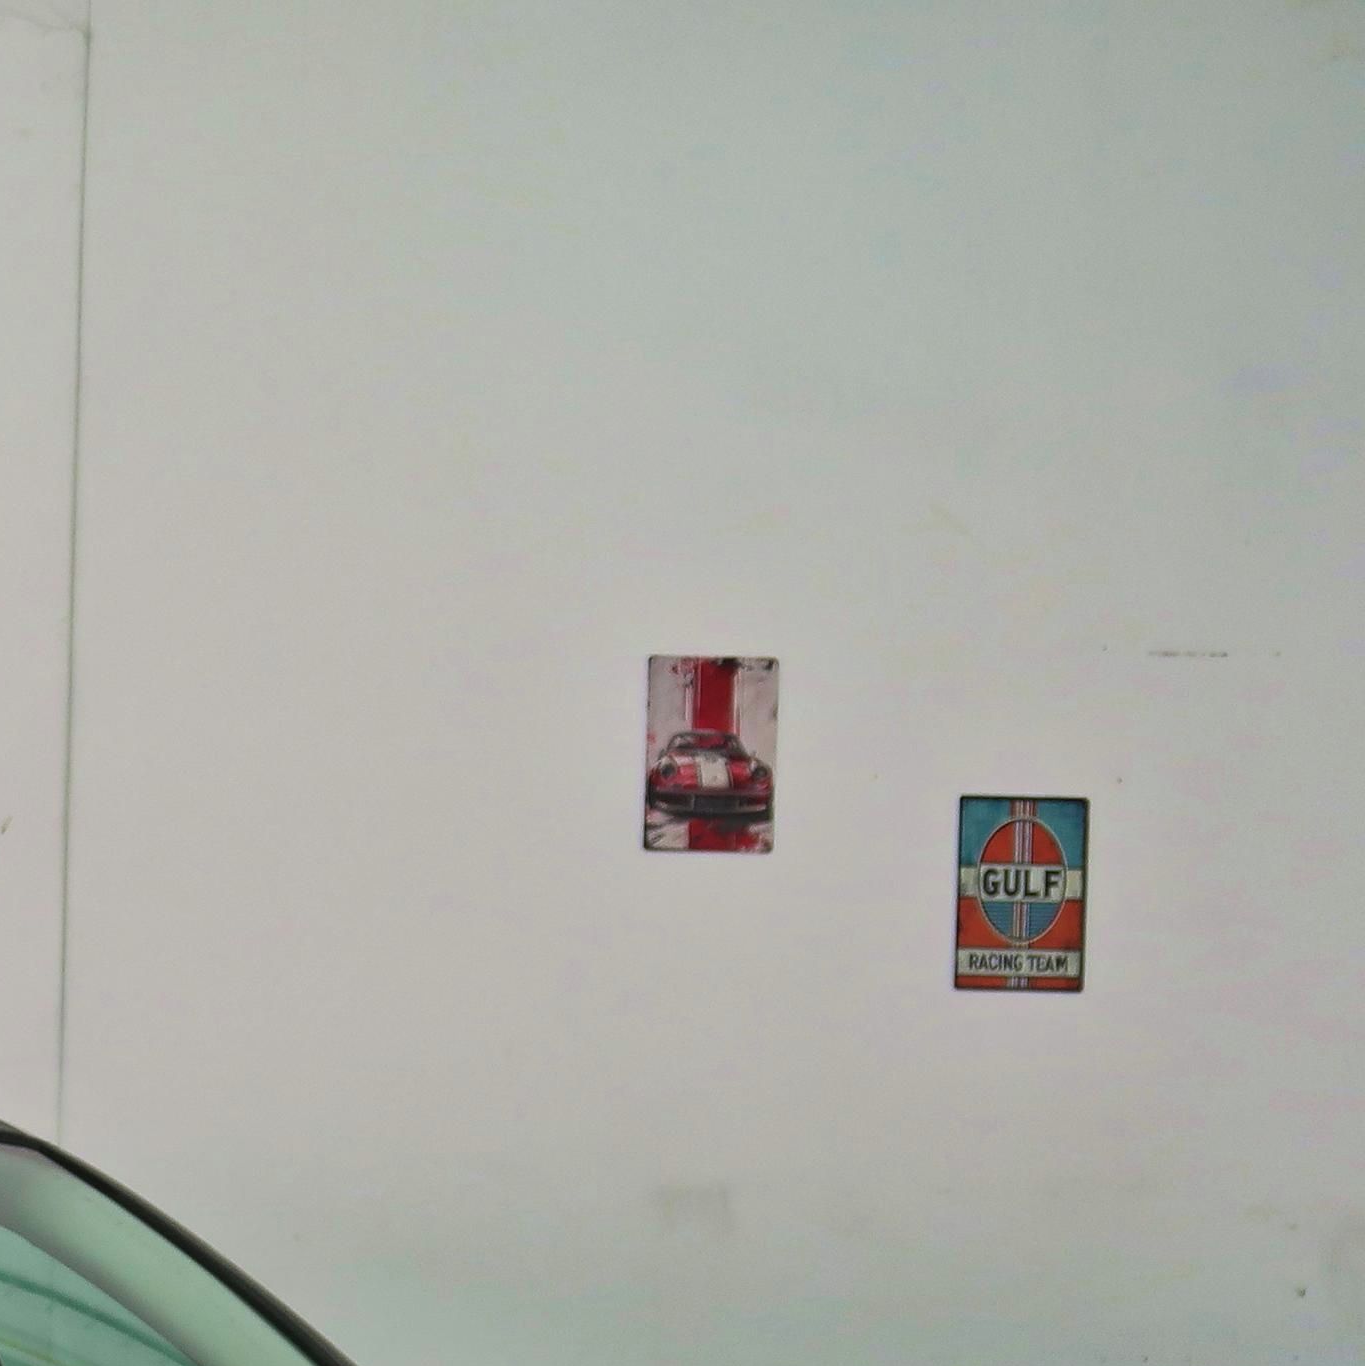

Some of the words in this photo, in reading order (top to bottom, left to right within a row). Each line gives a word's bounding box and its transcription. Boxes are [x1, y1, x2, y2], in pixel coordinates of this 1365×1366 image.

[982, 868, 1061, 898] GULF
[968, 953, 1023, 972] RACING
[1027, 954, 1069, 972] TEAM
